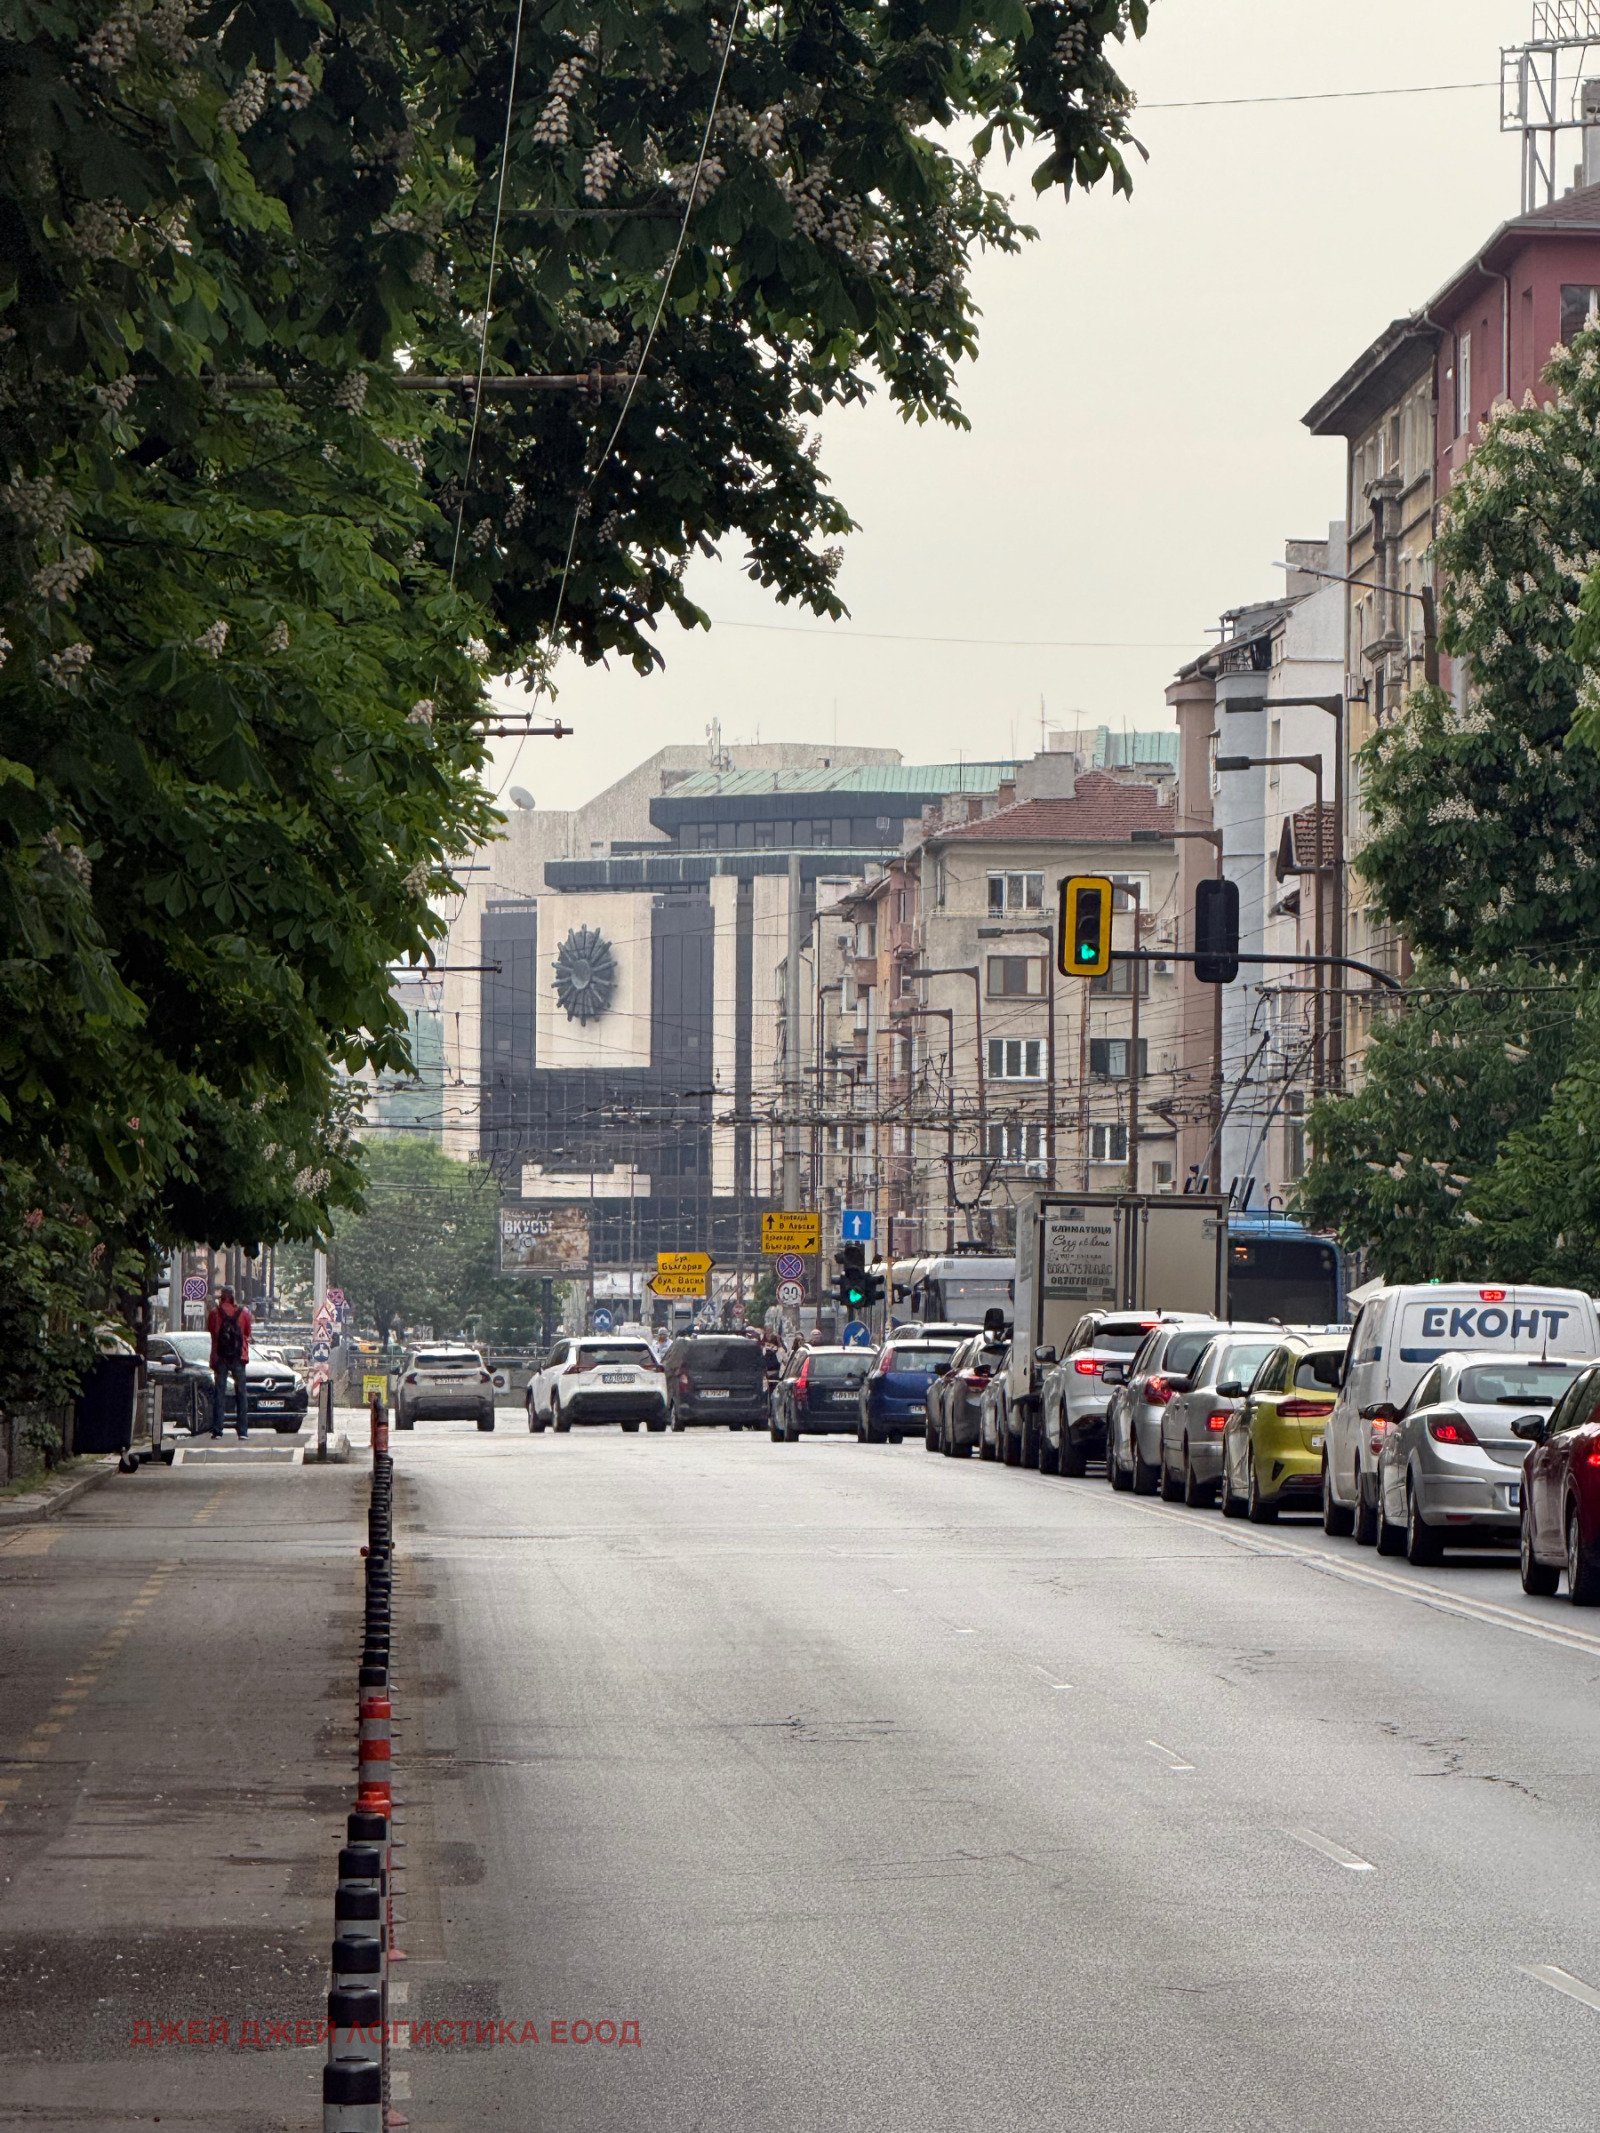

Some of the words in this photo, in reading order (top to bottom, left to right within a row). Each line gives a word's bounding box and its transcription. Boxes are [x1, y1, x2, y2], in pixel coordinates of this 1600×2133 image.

[504, 1220, 555, 1234] ВКУСЪТ
[1051, 1225, 1112, 1235] КЛИМАТИЦИ
[765, 1242, 800, 1251] България
[661, 1262, 703, 1272] България
[1422, 1307, 1570, 1340] ЕКОНТ
